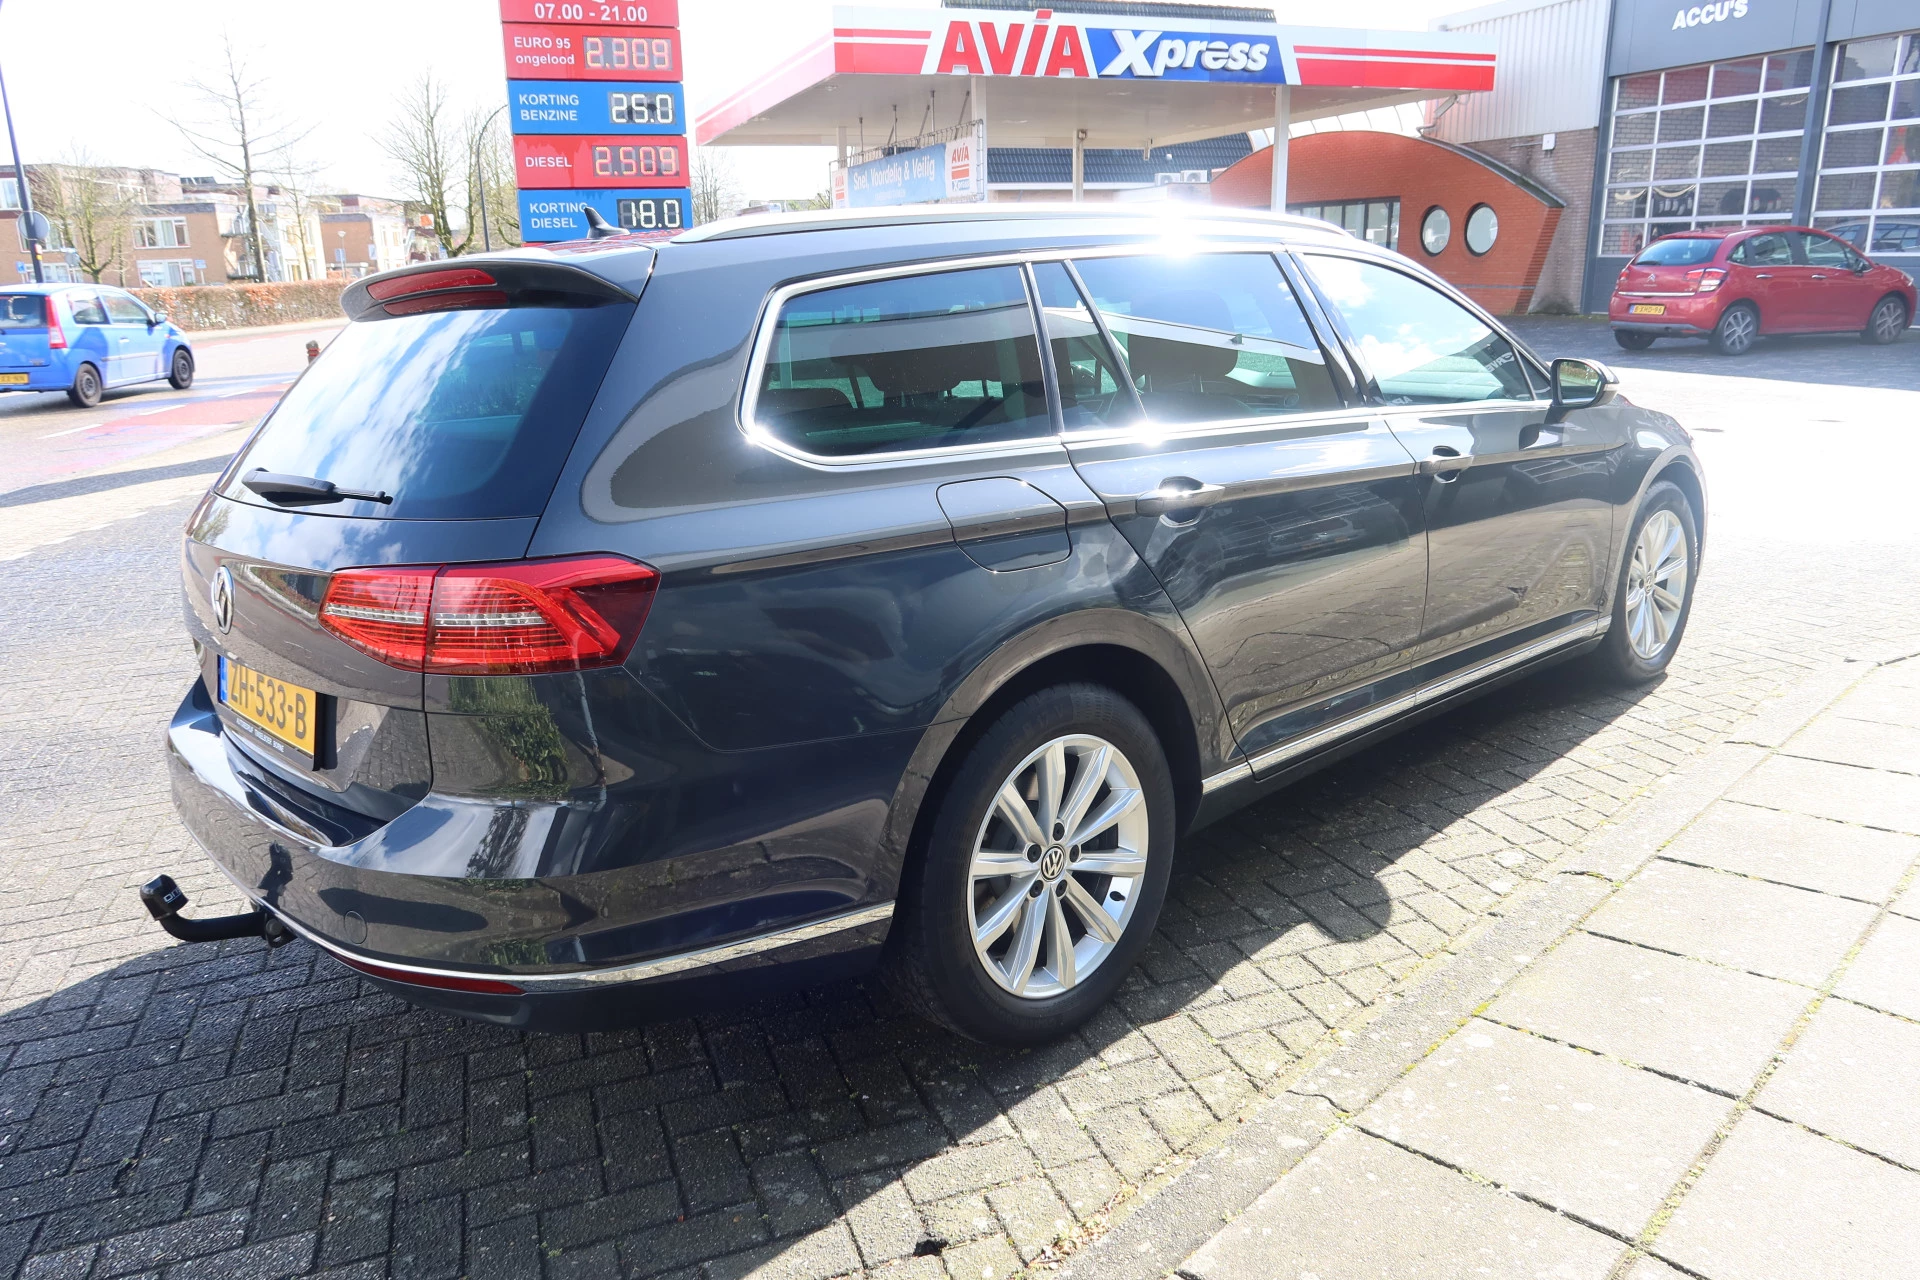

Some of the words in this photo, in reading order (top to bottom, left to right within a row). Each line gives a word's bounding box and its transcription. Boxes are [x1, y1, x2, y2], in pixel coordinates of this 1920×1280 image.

[534, 3, 583, 20] 07.00
[600, 5, 648, 22] 21.00
[1671, 0, 1748, 31] ACCU'S
[513, 36, 552, 49] EURO
[555, 37, 571, 49] 95
[586, 37, 671, 69] 2.309
[936, 9, 1090, 77] AVIA
[1099, 29, 1271, 77] Xpress
[515, 54, 575, 66] ongelood
[518, 93, 579, 106] KORTING
[611, 93, 673, 124] 25.0
[520, 109, 578, 121] BENZINE
[525, 156, 572, 168] DIESEL
[595, 146, 677, 176] 2.509
[870, 162, 902, 187] Voordelig
[904, 160, 910, 181] &
[912, 155, 935, 181] Veilig
[529, 202, 588, 214] KORTING
[631, 199, 680, 229] 18.0
[531, 217, 578, 229] DIESEL
[230, 660, 307, 740] ZH-533-B
